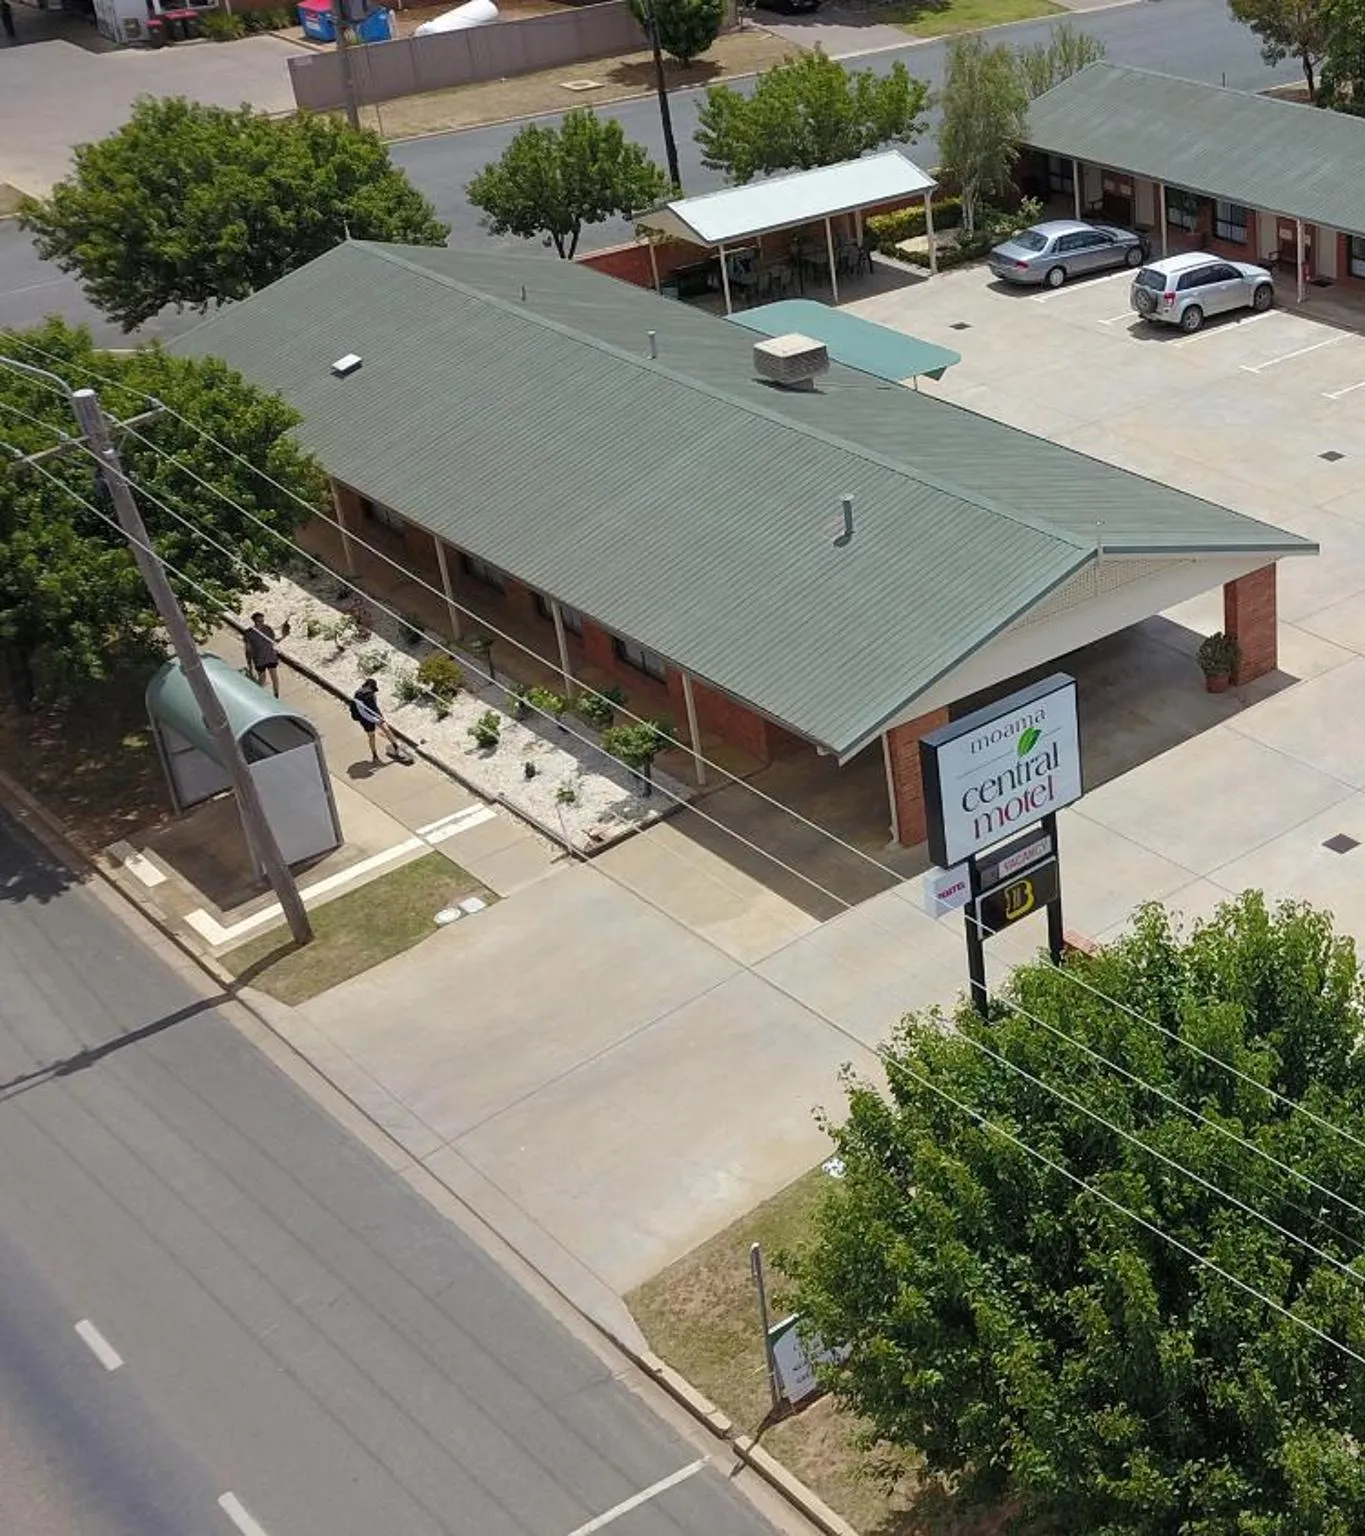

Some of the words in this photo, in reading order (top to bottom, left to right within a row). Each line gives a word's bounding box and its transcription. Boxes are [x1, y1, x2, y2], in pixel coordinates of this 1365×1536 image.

[970, 707, 1046, 755] moama
[961, 741, 1059, 813] central
[973, 774, 1055, 840] motel
